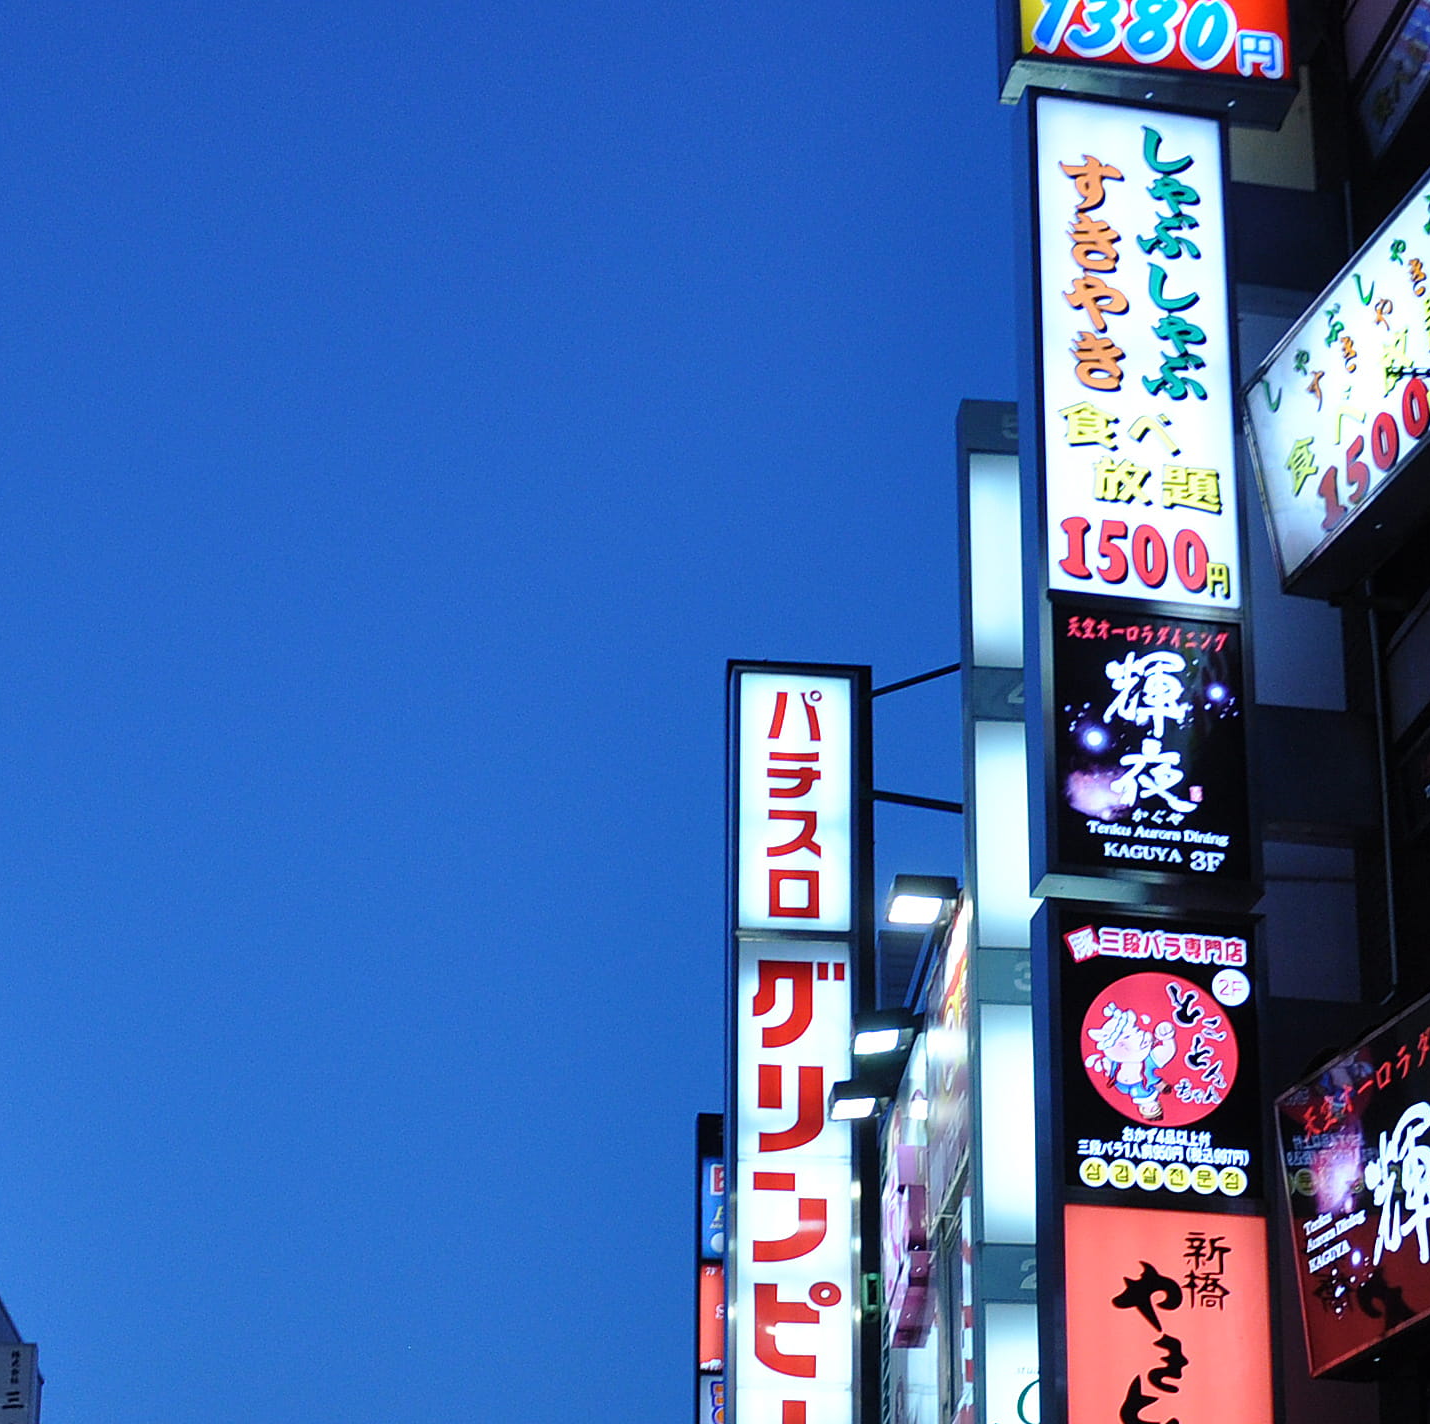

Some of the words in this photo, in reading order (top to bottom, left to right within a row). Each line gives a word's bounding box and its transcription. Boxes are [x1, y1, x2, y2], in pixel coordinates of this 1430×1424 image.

[1058, 155, 1129, 393] すきやき
[1141, 126, 1208, 402] しゃぶしゃぶ
[1058, 516, 1230, 598] 1500円
[1102, 651, 1198, 814] 輝夜
[767, 690, 822, 919] パチスロ
[1103, 842, 1184, 864] KAGUYA
[1189, 850, 1226, 873] 3F
[1217, 977, 1244, 997] 2F
[1182, 1231, 1233, 1312] 新橋
